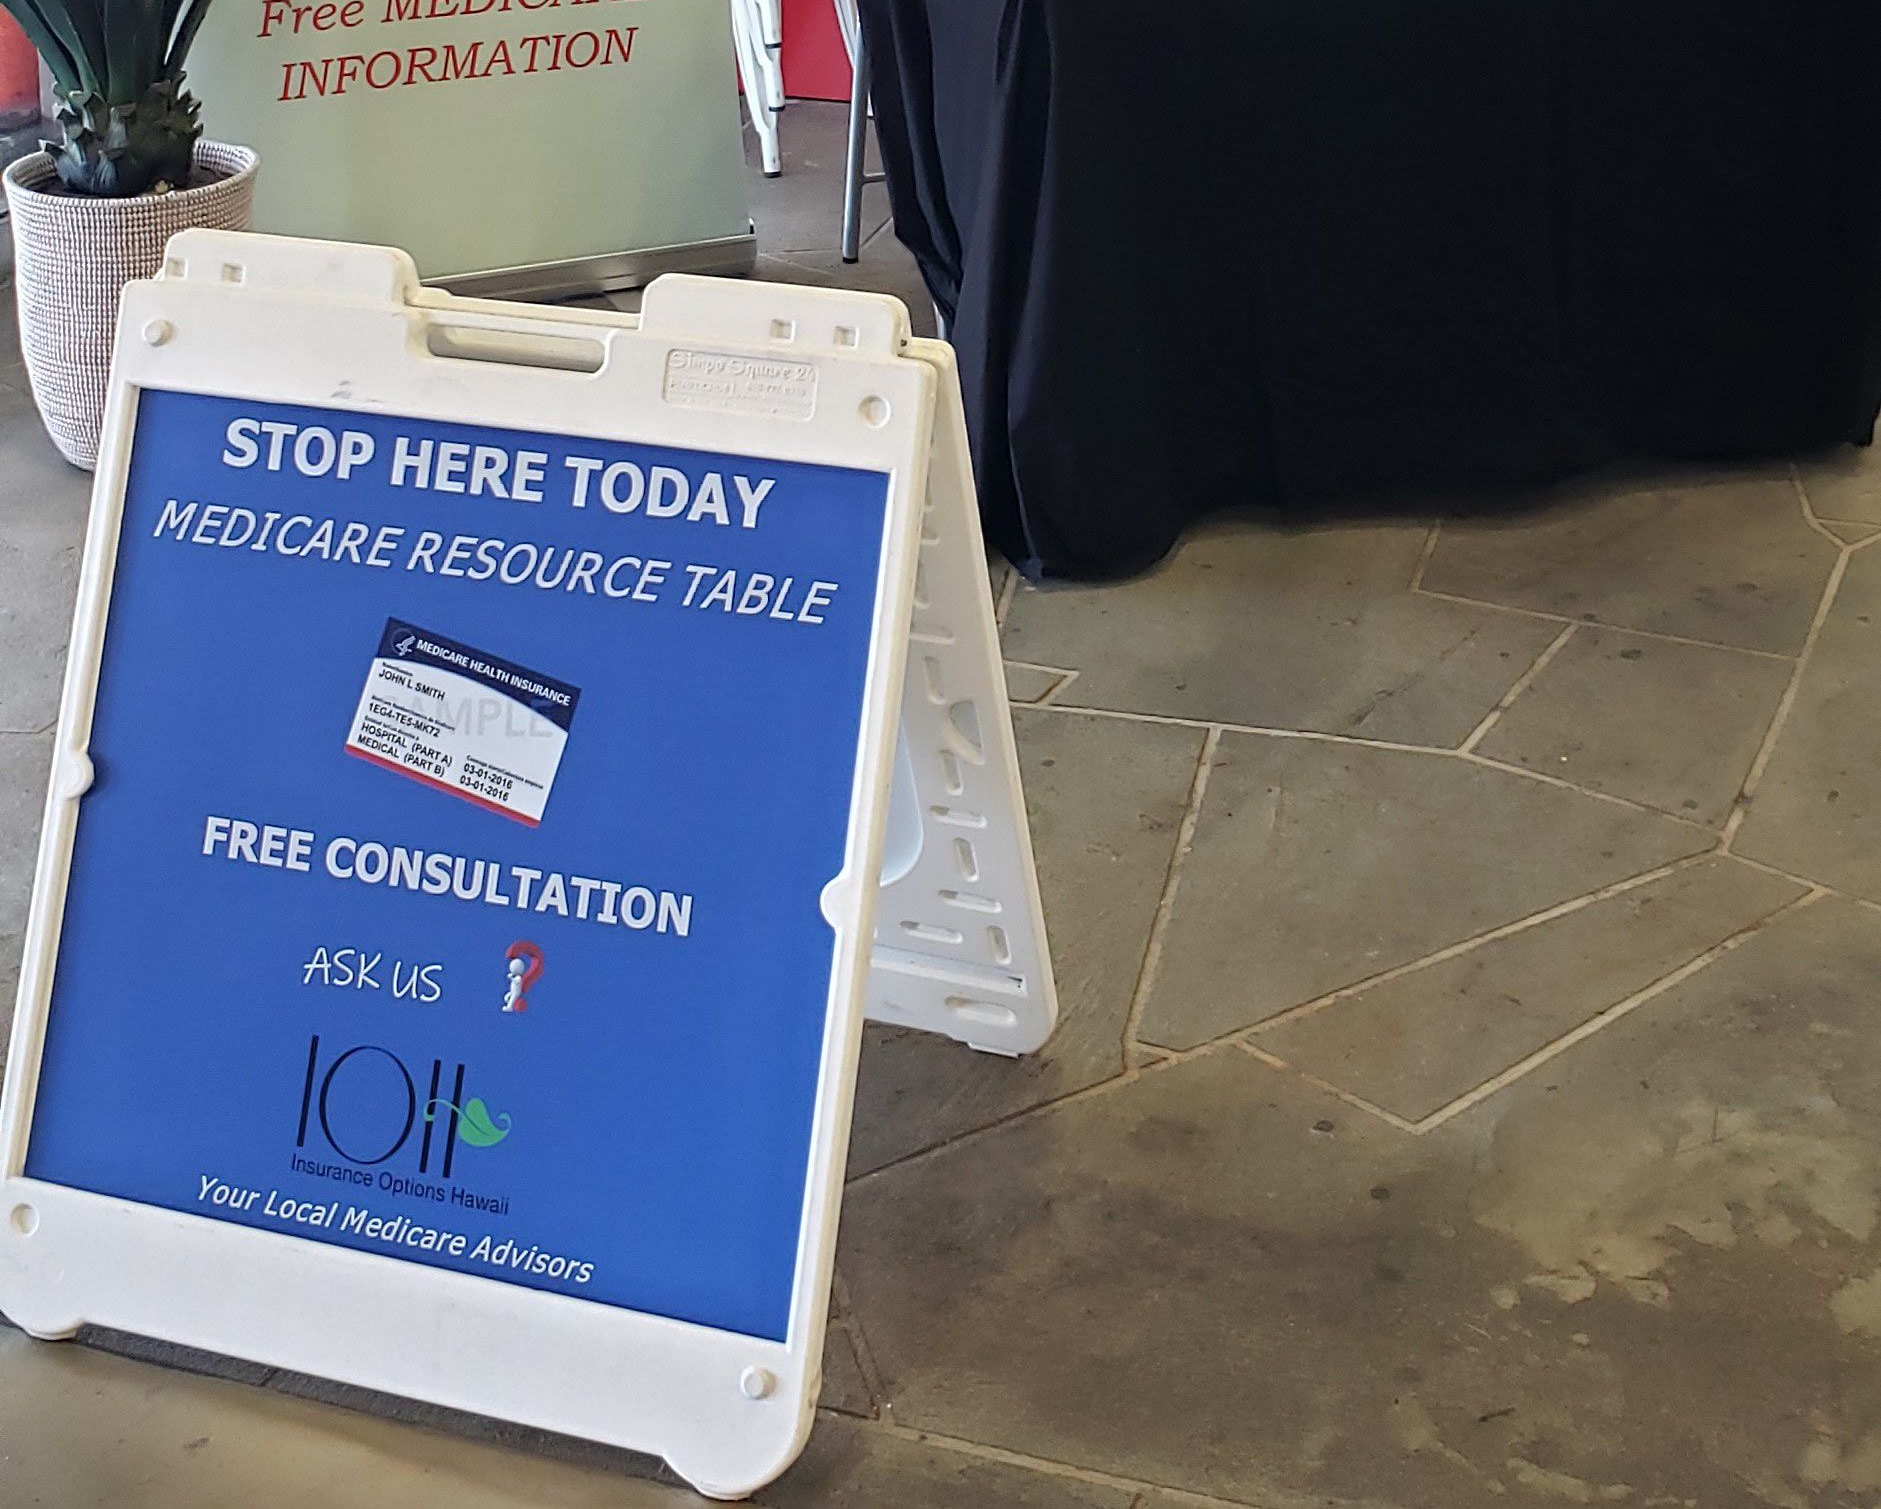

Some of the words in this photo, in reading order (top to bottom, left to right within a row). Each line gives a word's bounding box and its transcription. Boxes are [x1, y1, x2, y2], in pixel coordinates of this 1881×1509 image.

[277, 27, 639, 101] INFORMATION
[222, 418, 375, 481] STOP
[392, 436, 548, 503] HERE
[564, 456, 776, 529] TODAY
[154, 500, 406, 568] MEDICARE
[409, 534, 672, 603] RESOURCE
[682, 565, 838, 624] TABLE
[379, 669, 406, 685] JOHN
[407, 679, 413, 689] L
[414, 682, 446, 700] SMITH
[416, 639, 470, 667] MEDICARE
[470, 659, 510, 684] HEALTH
[510, 674, 572, 707] INSURANCE
[361, 722, 408, 748] HOSPITAL
[411, 742, 439, 763] (PART
[438, 750, 453, 767] A)
[368, 702, 441, 737] 1EG4-TE5-MK72
[357, 734, 400, 758] MEDICAL
[403, 753, 432, 774] (PART
[432, 761, 445, 778] B)
[463, 762, 513, 790] 03-01-2016
[459, 775, 509, 802] 03-01-2016
[202, 816, 314, 872] FREE
[325, 837, 693, 936] CONSULTATION
[303, 947, 382, 989] ASK
[392, 961, 443, 1002] US
[291, 1153, 373, 1188] Insurance
[379, 1172, 445, 1203] Options
[451, 1186, 510, 1217] Hawaii
[198, 1175, 260, 1211] Your
[264, 1190, 338, 1229] Local
[341, 1206, 466, 1257] Medicare
[470, 1235, 595, 1284] Advisors
